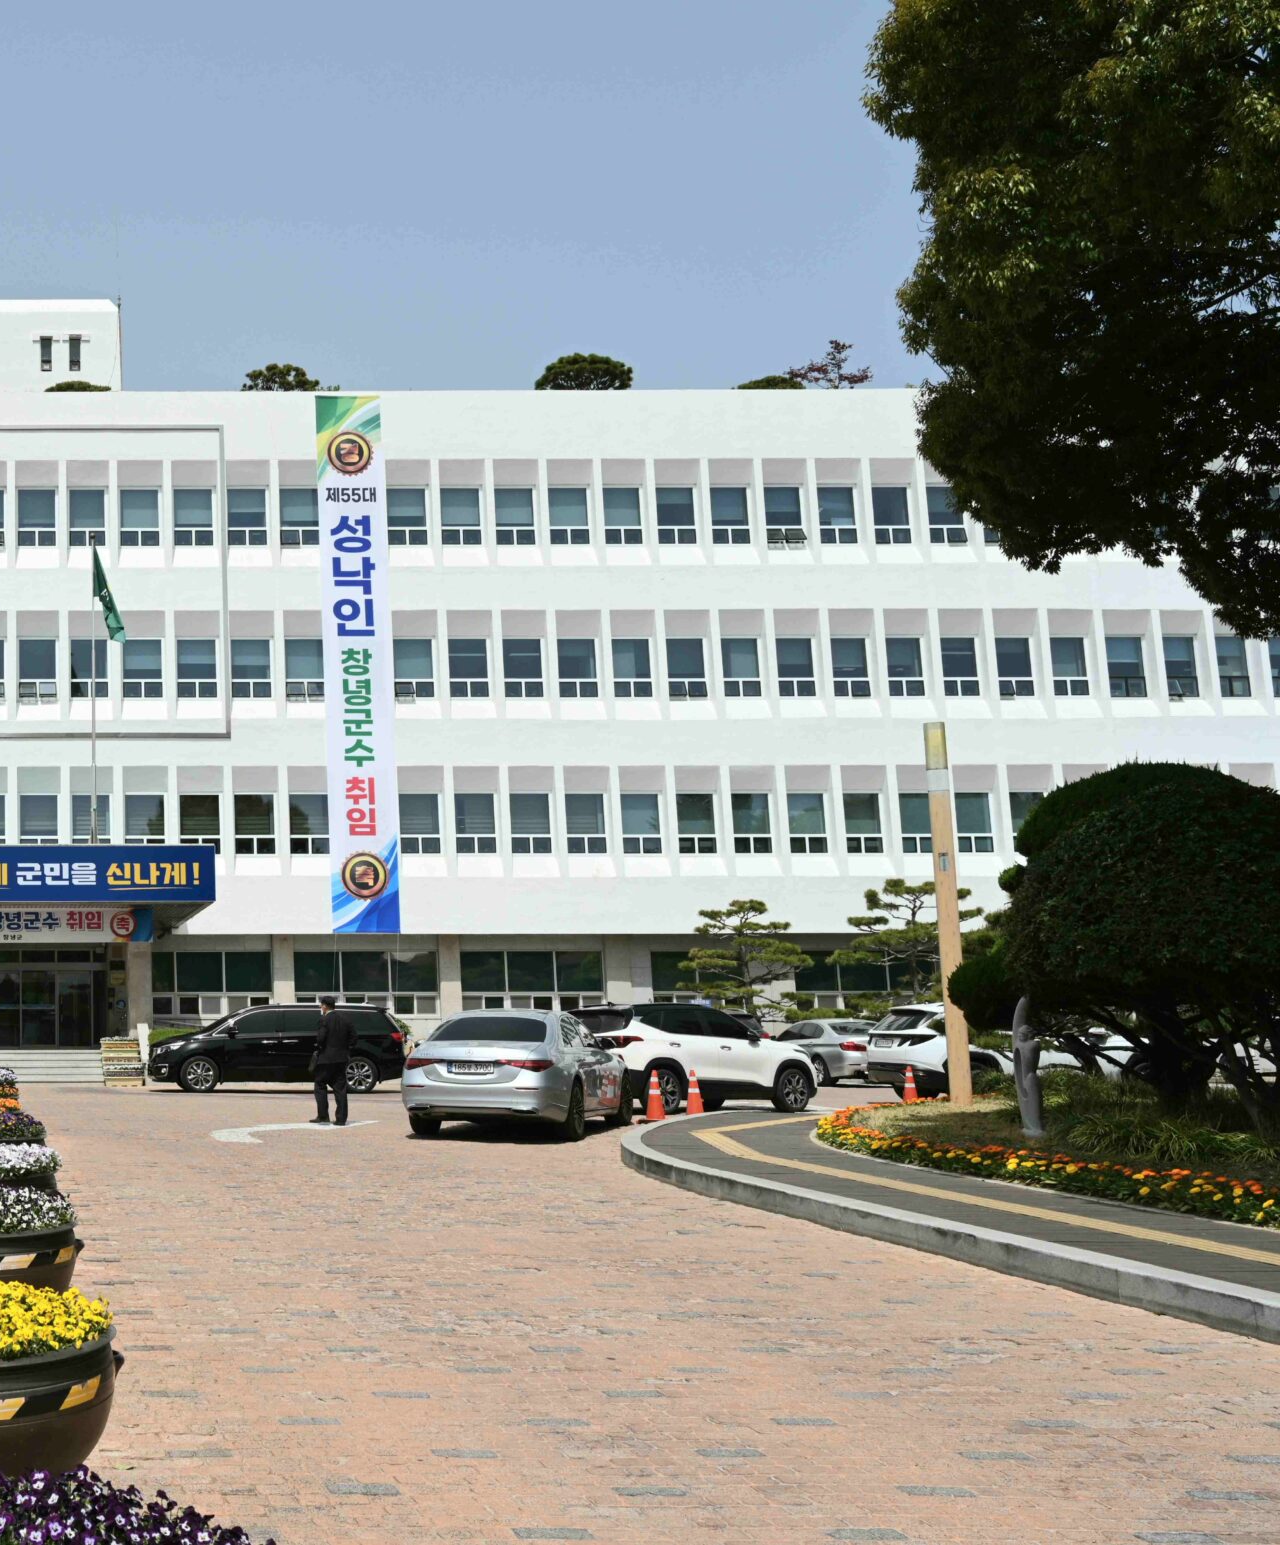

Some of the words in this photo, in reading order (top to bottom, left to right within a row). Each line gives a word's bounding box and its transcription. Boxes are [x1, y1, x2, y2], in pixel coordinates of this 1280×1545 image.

[325, 487, 377, 503] 제55대
[330, 515, 376, 637] 성낙인
[341, 648, 375, 767] 창녕군수
[345, 776, 377, 836] 취임
[16, 862, 97, 886] 군민을
[66, 911, 103, 931] 취임
[116, 917, 131, 932] 축
